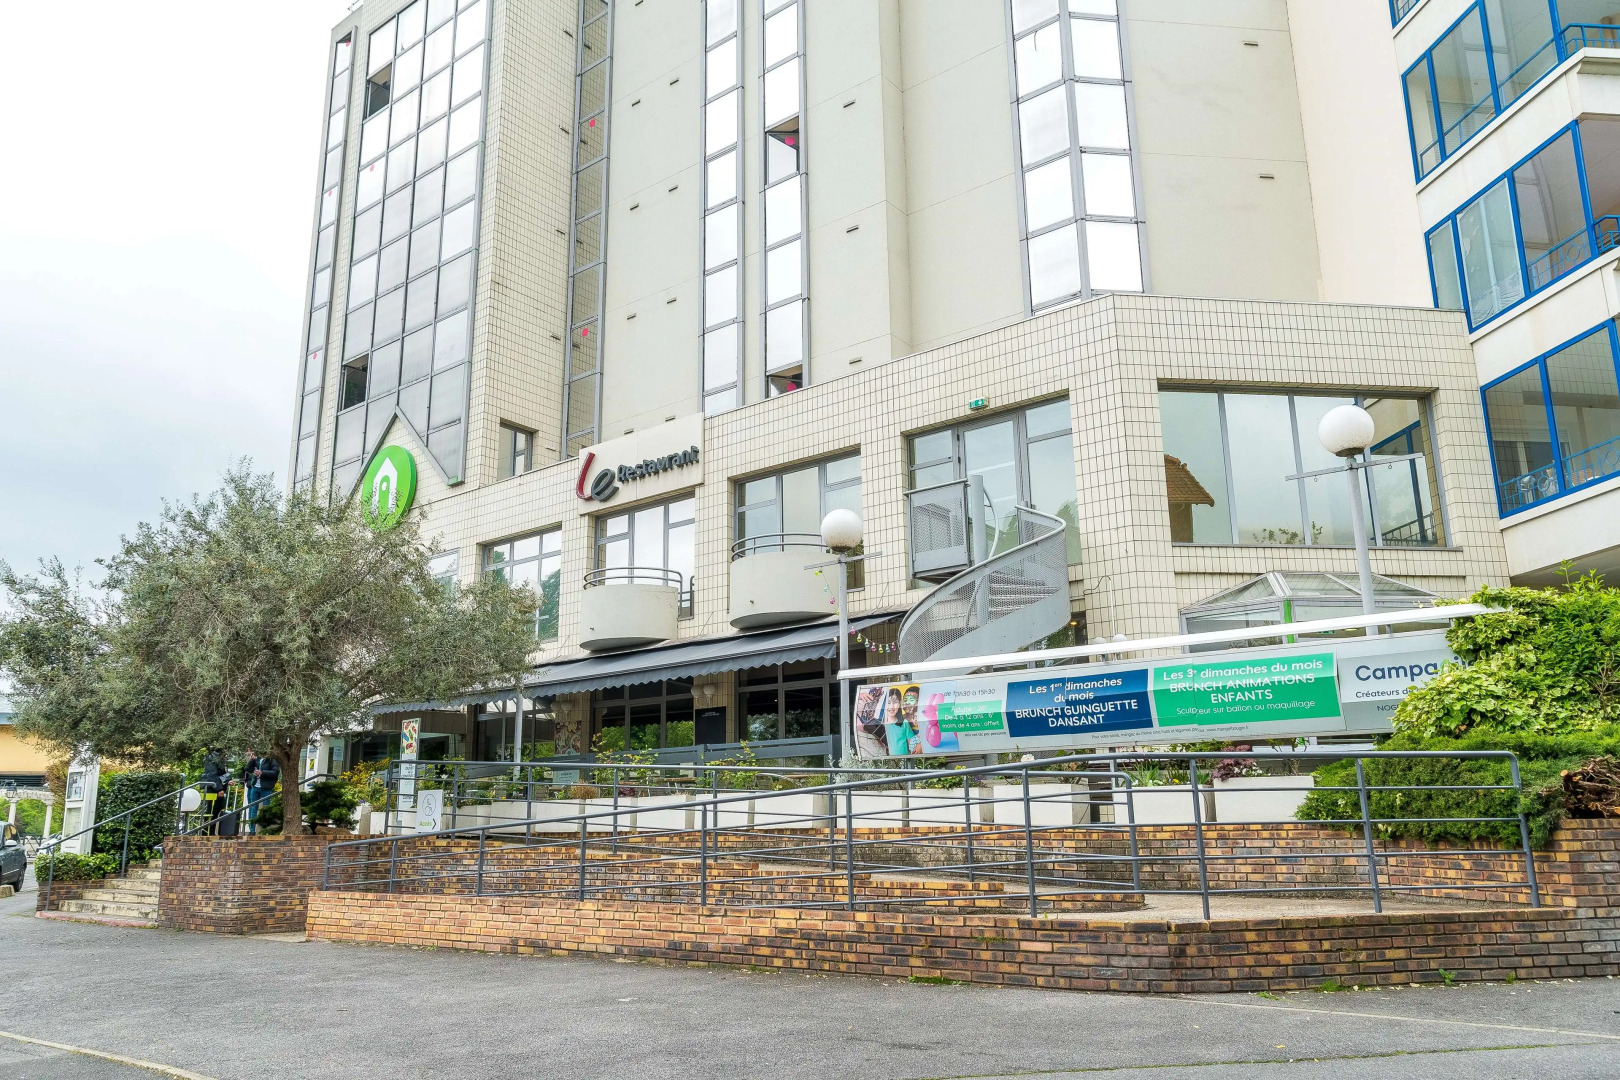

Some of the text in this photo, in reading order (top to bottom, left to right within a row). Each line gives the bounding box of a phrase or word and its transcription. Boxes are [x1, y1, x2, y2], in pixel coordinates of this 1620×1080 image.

[576, 445, 700, 502] Le Restaurant
[1163, 671, 1184, 681] Les
[1200, 665, 1268, 679] dimanches
[1271, 662, 1288, 673] du
[1291, 659, 1323, 671] mois
[1029, 685, 1047, 694] Les
[1064, 678, 1122, 691] dimanches
[1169, 673, 1315, 693] BRUNCH ANIMATIONS
[1068, 691, 1094, 701] mois
[1210, 689, 1273, 704] ENFANTS
[1355, 688, 1400, 699] Créateurs
[1015, 699, 1138, 719] BRUNCH GUINGUETTE
[1176, 707, 1211, 716] Sculpteur
[1213, 706, 1224, 714] sur
[1226, 704, 1253, 713] ballon
[1266, 700, 1316, 710] maquillage
[1048, 713, 1105, 728] DANSANT
